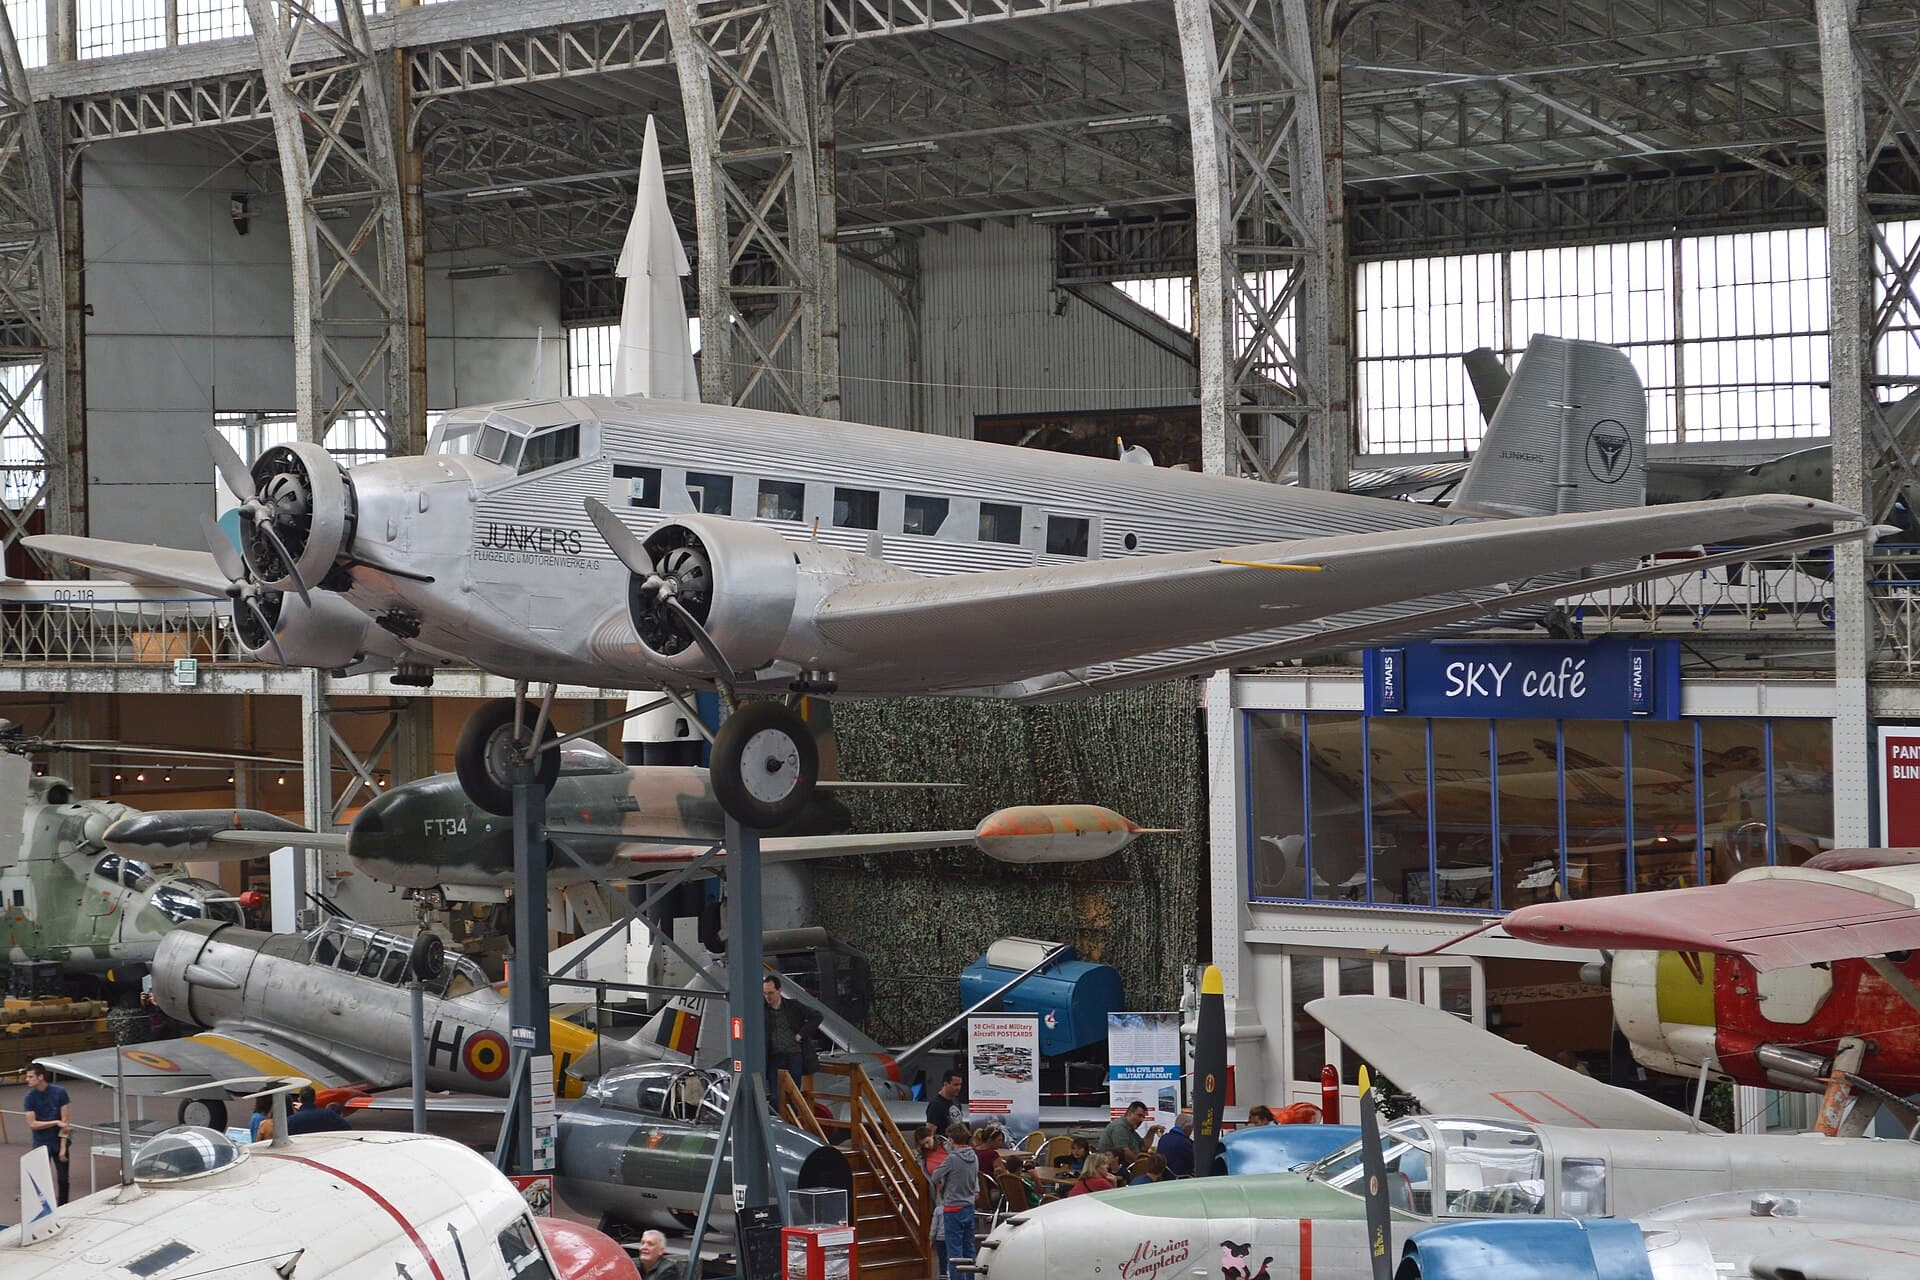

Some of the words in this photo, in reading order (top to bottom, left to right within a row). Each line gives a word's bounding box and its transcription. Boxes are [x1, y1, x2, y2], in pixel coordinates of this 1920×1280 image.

[482, 522, 582, 554] JUNKERS
[474, 550, 514, 563] FLUGZEUG
[1384, 656, 1393, 687] MAES
[1445, 662, 1513, 697] SKY
[1522, 656, 1587, 698] café
[1633, 656, 1642, 688] MAES
[1892, 745, 1920, 760] PAN
[1892, 765, 1920, 780] BLIN
[423, 818, 468, 837] FT34
[1009, 1023, 1033, 1031] Military
[428, 1019, 465, 1073] H
[1117, 1072, 1145, 1080] MILITARY
[1144, 1072, 1173, 1080] AIRCRAFT
[1118, 1247, 1189, 1280] Completed
[1130, 1239, 1189, 1264] Mission
